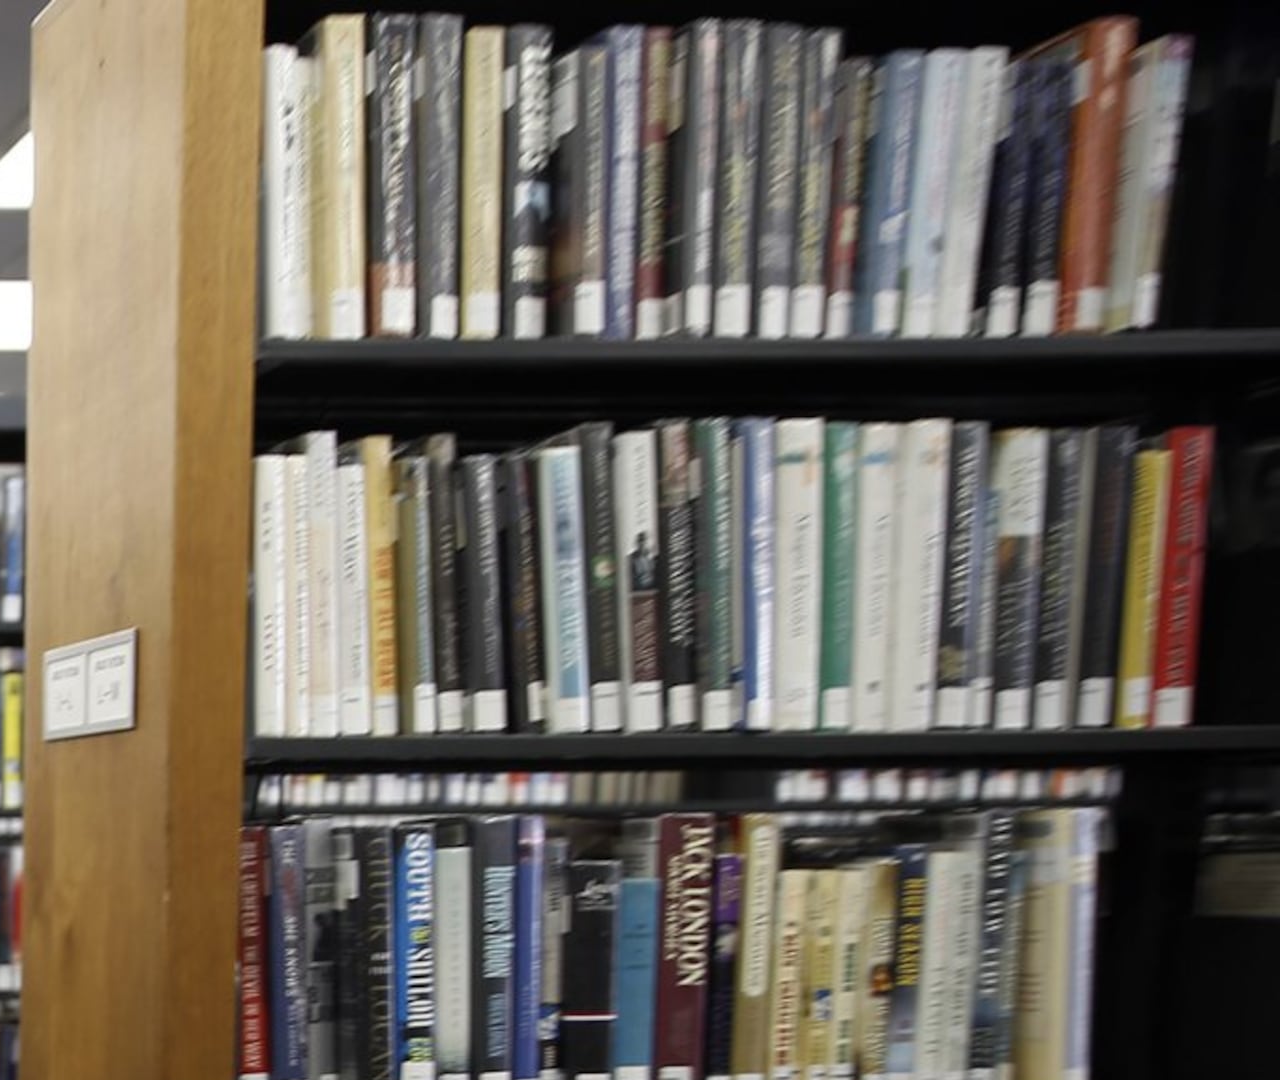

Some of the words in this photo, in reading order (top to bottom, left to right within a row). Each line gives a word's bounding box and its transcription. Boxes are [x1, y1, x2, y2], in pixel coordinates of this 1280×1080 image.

[406, 832, 436, 923] SOUTH
[680, 824, 714, 882] JACK
[676, 888, 709, 987] LONDON
